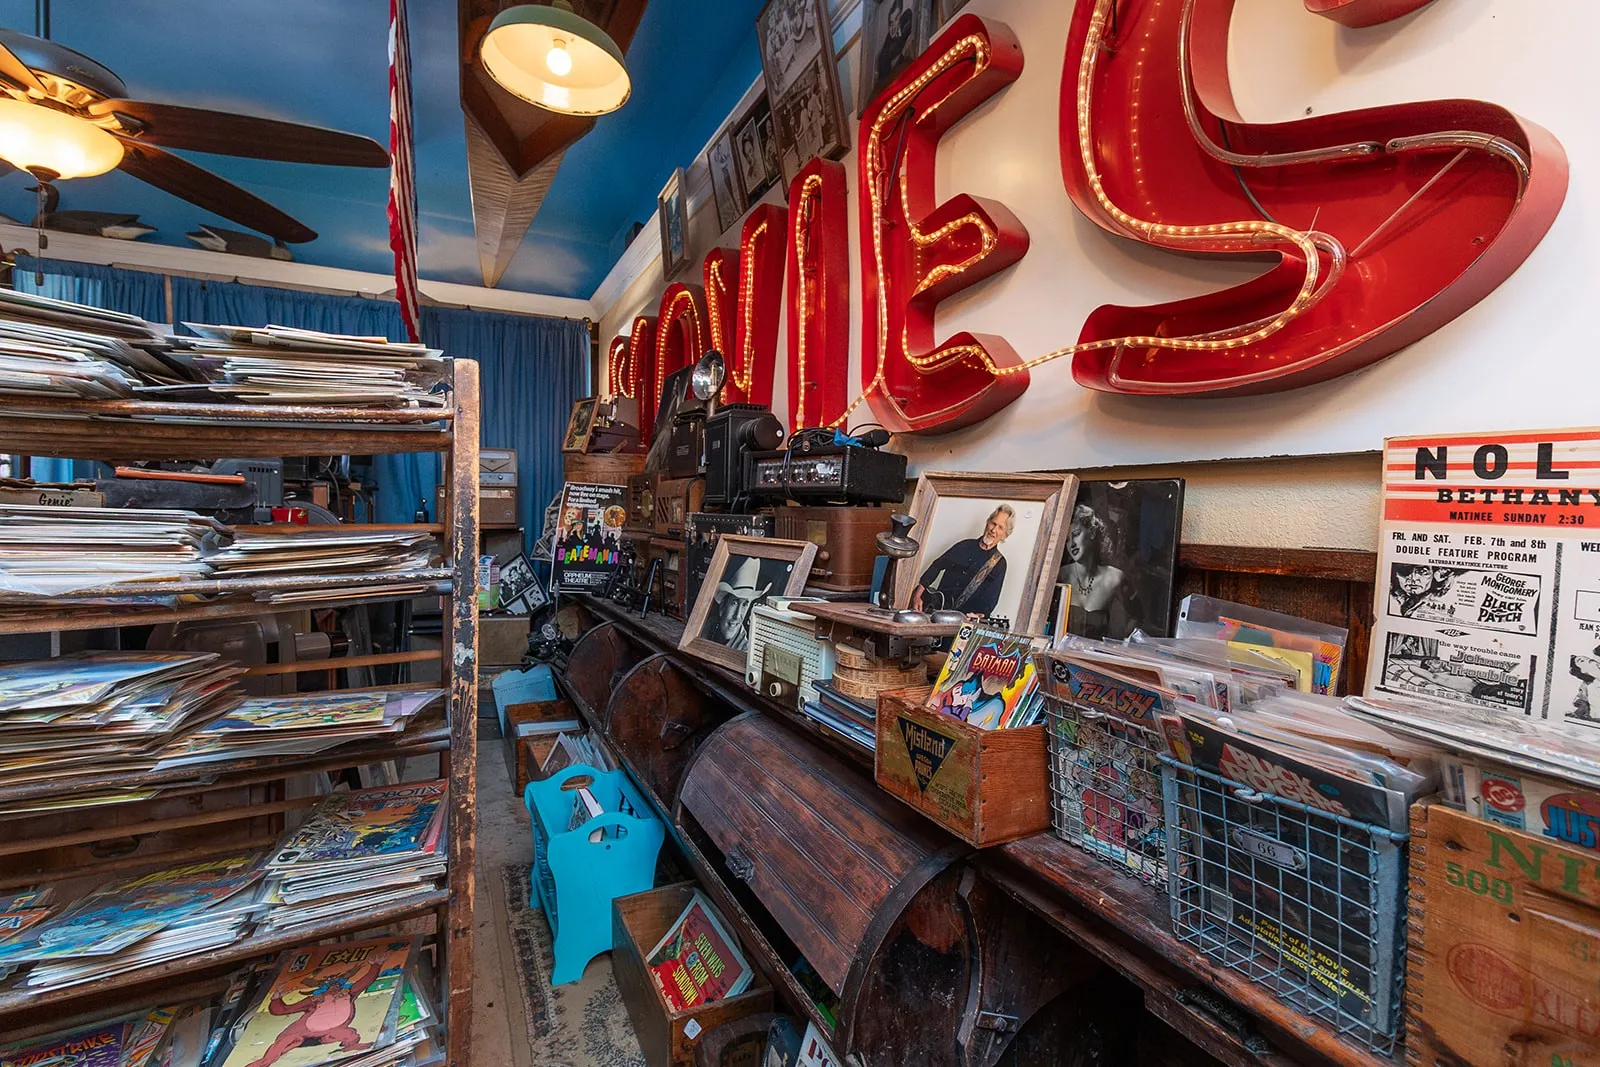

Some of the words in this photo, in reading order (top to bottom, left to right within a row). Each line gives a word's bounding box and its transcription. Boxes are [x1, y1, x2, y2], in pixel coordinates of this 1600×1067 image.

[1450, 511, 1493, 522] MATINEE
[1503, 513, 1547, 524] SUNDAY
[1558, 515, 1585, 525] 2:30
[1411, 533, 1428, 542] AND
[1433, 534, 1452, 544] SAT.
[1463, 535, 1486, 546] FEB.
[1490, 537, 1506, 547] 7th
[1510, 539, 1527, 548] and
[1530, 540, 1547, 549] 8th
[557, 545, 620, 565] BEATLEMANIA
[1395, 545, 1431, 556] DOUBLE
[1438, 547, 1480, 559] FEATURE
[1487, 551, 1538, 563] PROGRAM
[1480, 575, 1538, 598] MONTGOMERY
[1495, 572, 1527, 589] GEORGE
[1480, 592, 1525, 613] BLACK
[1477, 607, 1523, 623] PATCH
[1439, 640, 1451, 648] the
[1453, 643, 1469, 651] way
[1470, 646, 1498, 656] trouble
[1499, 651, 1522, 660] came
[973, 651, 1017, 676] BATMAN
[1449, 650, 1521, 673] Johnny
[1448, 662, 1518, 687] Trouble
[1075, 682, 1156, 718] FLASH
[905, 721, 946, 760] Mistland
[1223, 743, 1313, 791] BUCK
[352, 783, 445, 802] ROBOTIX
[1219, 758, 1352, 819] ROGERS
[1257, 841, 1276, 857] 66
[705, 950, 726, 979] WAYS
[672, 964, 699, 1007] SUNDOWN
